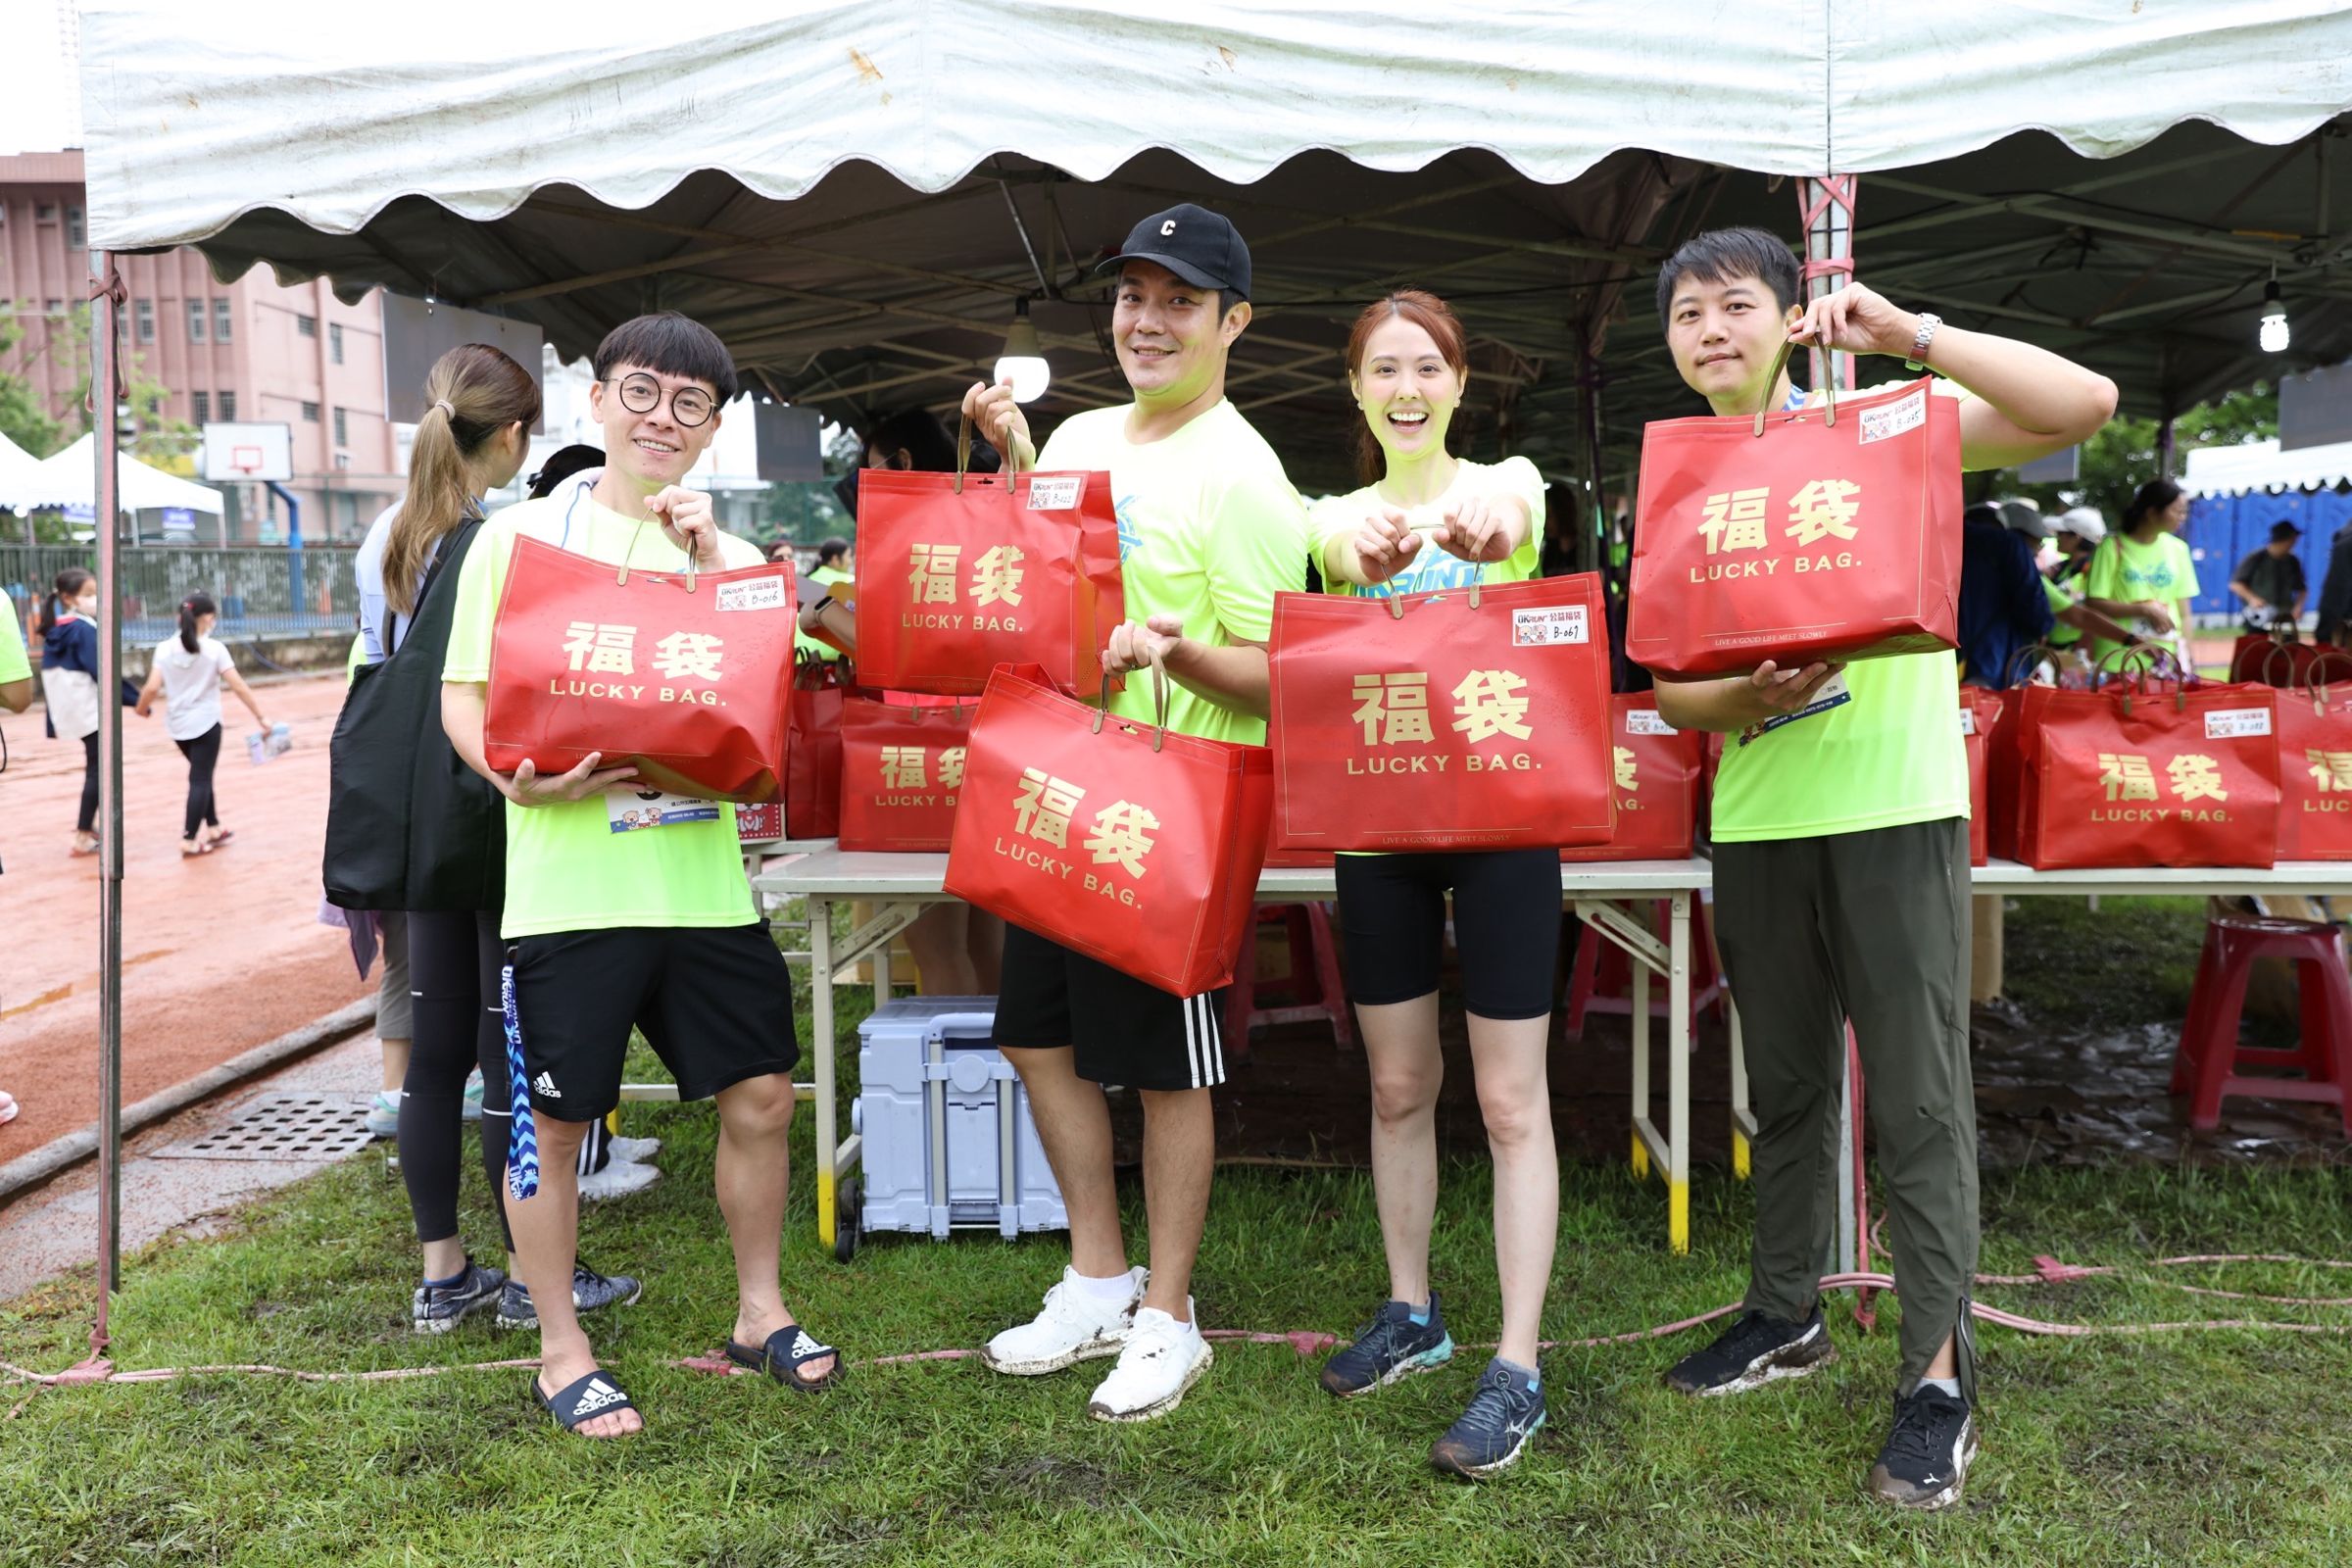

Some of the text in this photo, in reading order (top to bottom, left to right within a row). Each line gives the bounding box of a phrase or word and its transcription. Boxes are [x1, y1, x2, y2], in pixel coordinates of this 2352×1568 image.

[1160, 220, 1176, 236] C
[1697, 478, 1861, 556] 福袋
[908, 543, 1025, 608] 福袋
[1690, 552, 1862, 583] LUCKY BAG.
[752, 590, 778, 605] B-016
[902, 612, 1023, 632] LUCKY BAG.
[562, 620, 724, 681] 福袋
[550, 679, 727, 707] LUCKY BAG.
[1351, 669, 1534, 746] 福袋
[1347, 753, 1542, 775] LUCKY BAG.
[2097, 753, 2229, 803] 福袋
[875, 795, 937, 807] LUCKY
[2090, 808, 2233, 822] LUCKY BAG.
[1012, 766, 1161, 880] 福袋
[994, 837, 1144, 910] LUCKY BAG.
[572, 1391, 628, 1417] adidas
